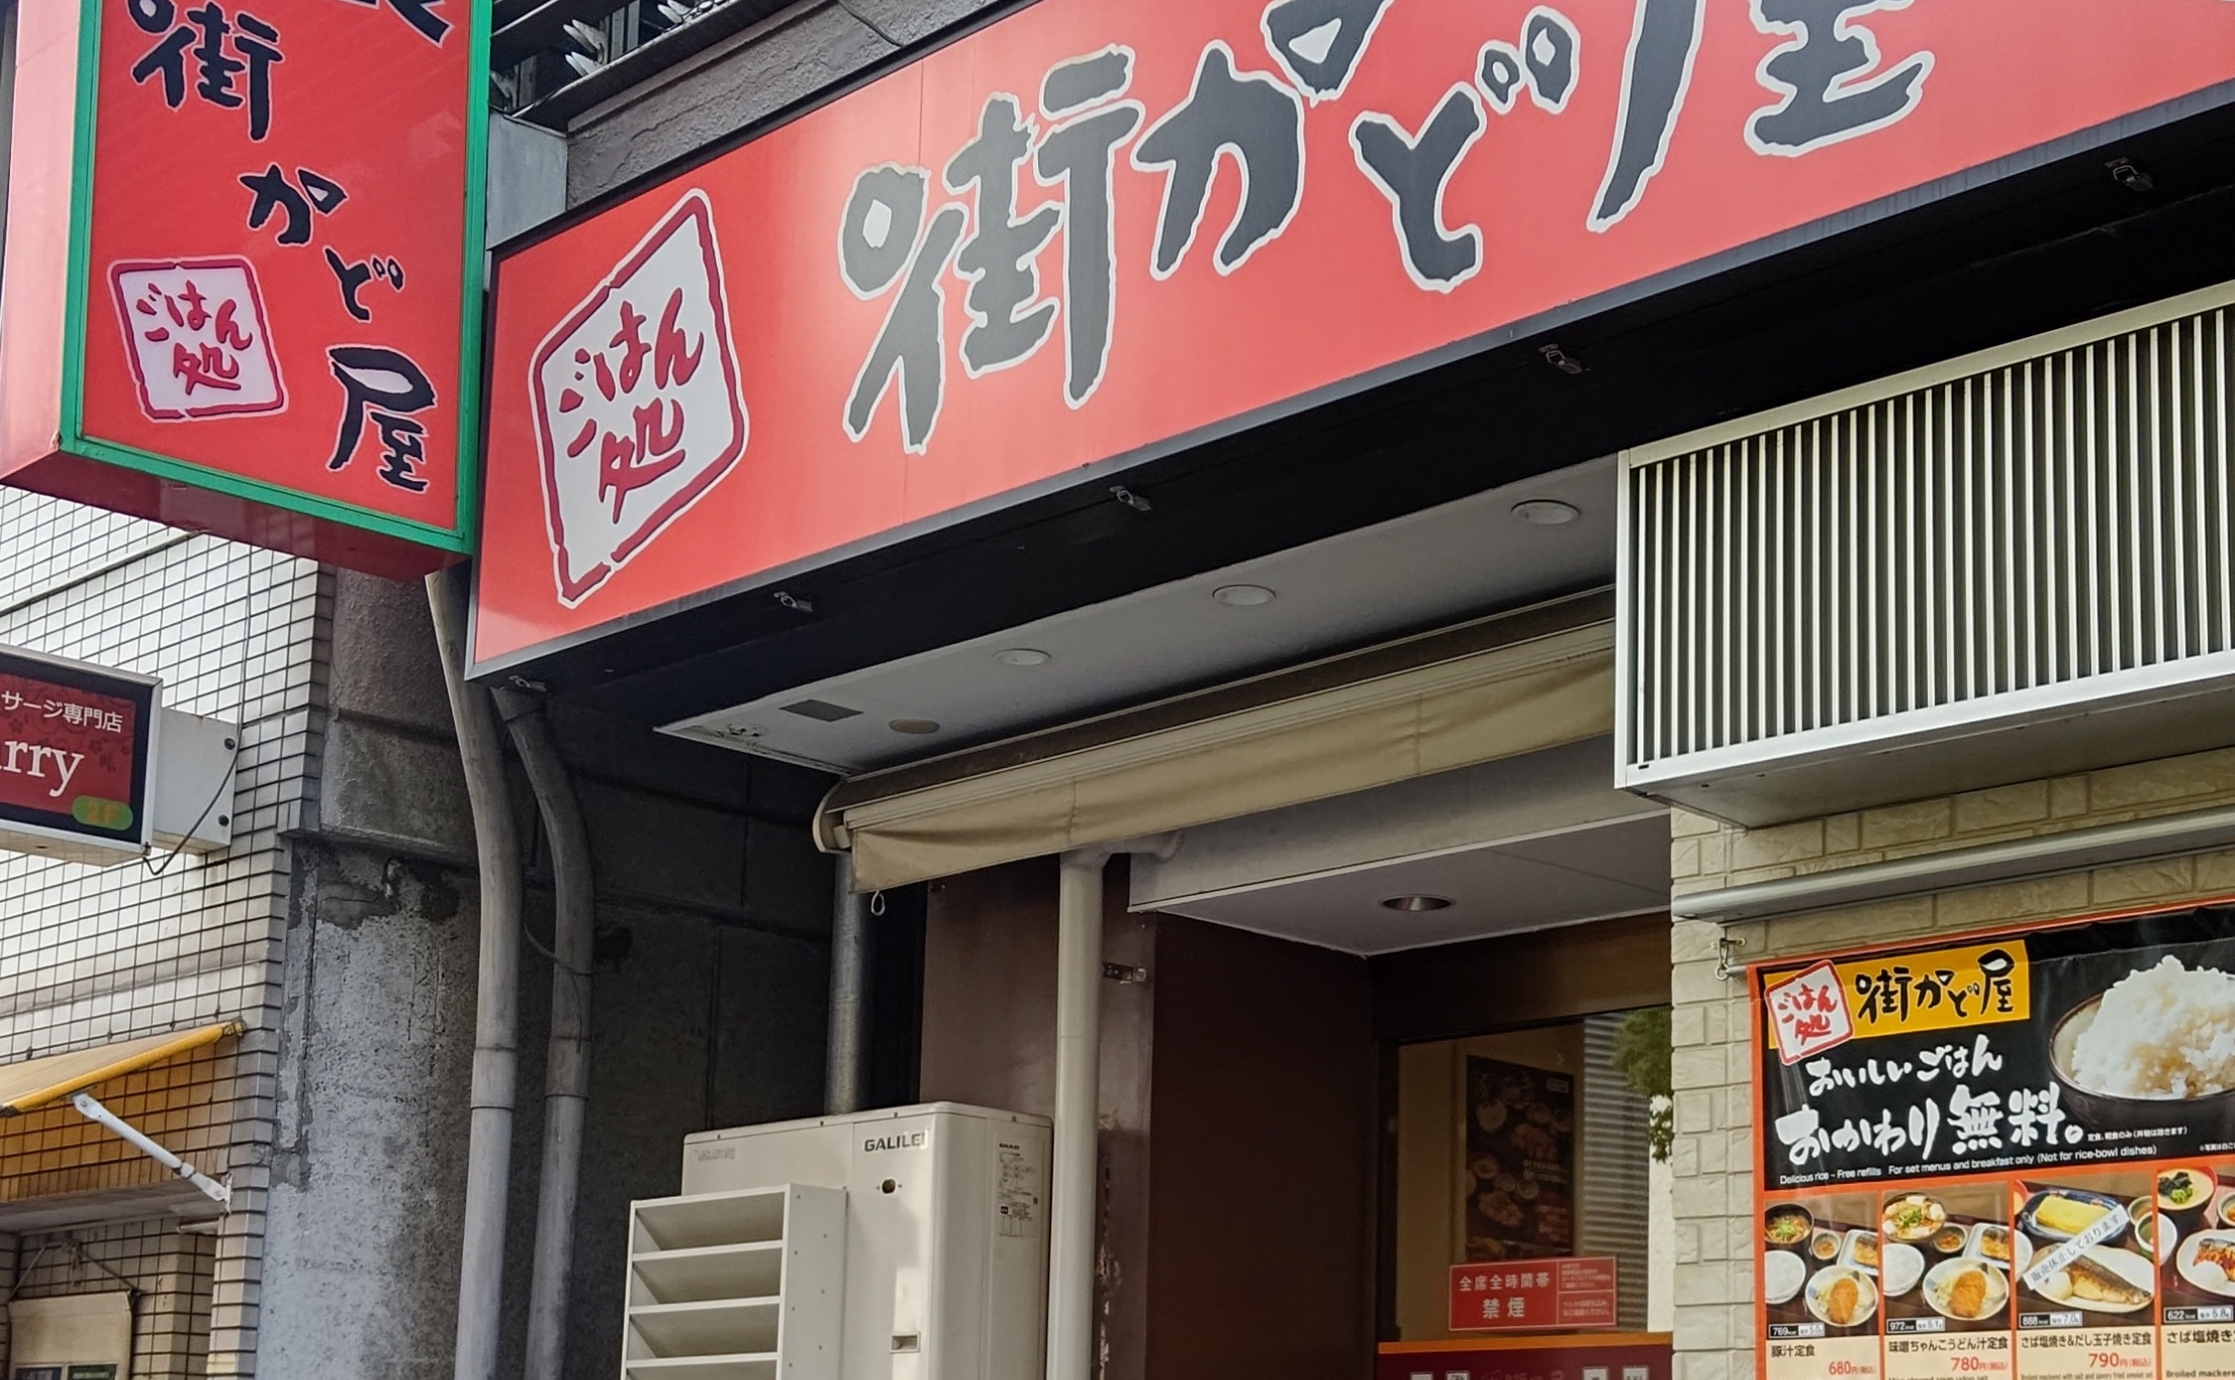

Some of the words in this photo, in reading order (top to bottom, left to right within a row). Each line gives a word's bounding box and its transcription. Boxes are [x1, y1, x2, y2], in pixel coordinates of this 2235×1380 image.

[1, 690, 123, 733] サージ専門店
[0, 740, 84, 797] rry
[1855, 948, 2015, 1024] 街かど屋
[1805, 1034, 2002, 1096] おいしいごはん
[1779, 1173, 1814, 1185] Delicious
[1814, 1172, 1829, 1182] rice
[1837, 1169, 1856, 1179] Free
[1857, 1167, 1882, 1177] refills
[1888, 1165, 1903, 1175] For
[1905, 1164, 1920, 1174] set
[1921, 1162, 1951, 1172] menus
[1953, 1160, 1970, 1170] and
[1971, 1157, 2013, 1169] breakfast
[2015, 1154, 2034, 1166] only
[2037, 1152, 2057, 1164] (Not
[2058, 1150, 2073, 1161] for
[2075, 1147, 2119, 1159] rice-bowl
[2120, 1144, 2157, 1157] dishes)
[1459, 1272, 1549, 1292] 全席全時間帯
[1482, 1296, 1525, 1320] 禁煙
[1771, 1344, 1815, 1357] 豚汁定食
[2166, 1329, 2235, 1344] さば塩焼き
